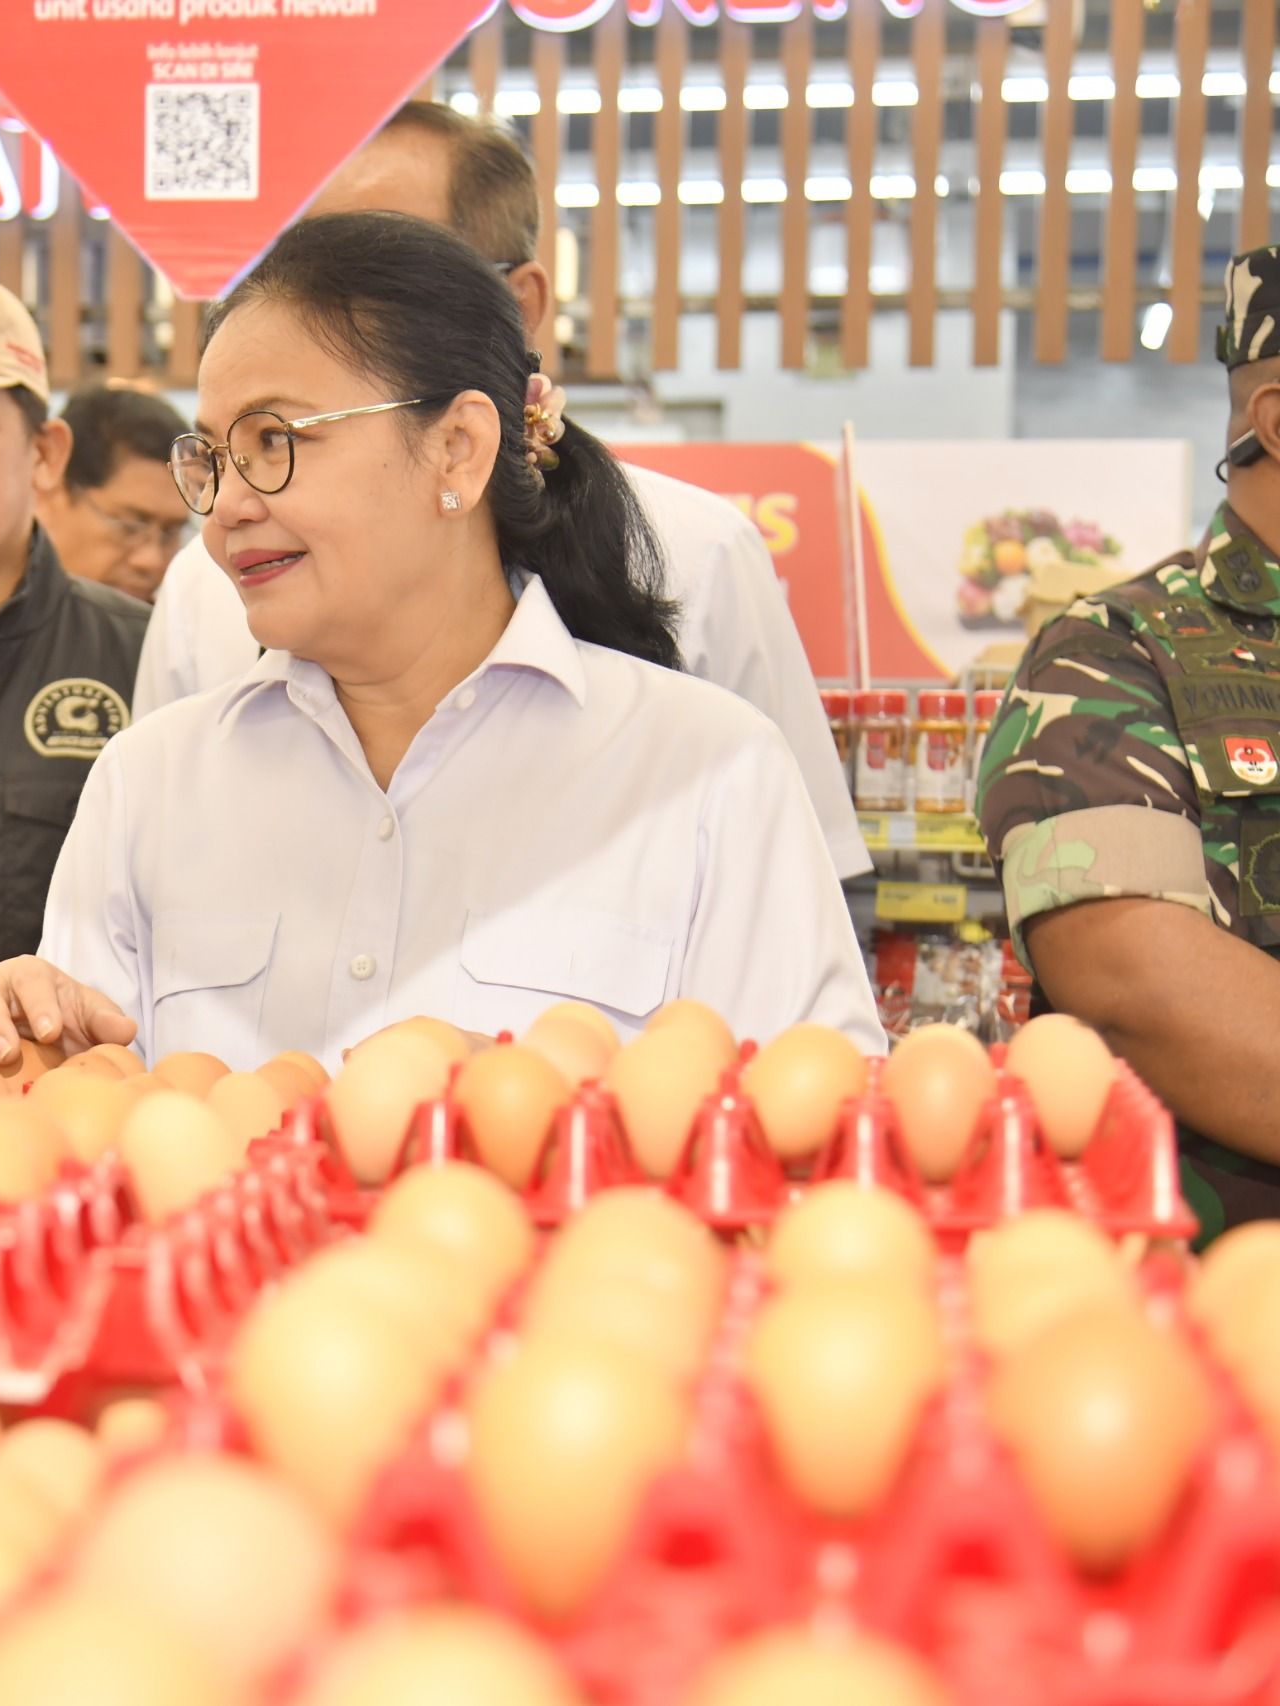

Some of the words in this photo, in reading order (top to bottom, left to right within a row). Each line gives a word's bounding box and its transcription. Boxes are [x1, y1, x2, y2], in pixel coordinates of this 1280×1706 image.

[152, 61, 197, 80] SCAN
[201, 61, 217, 80] DI
[221, 60, 254, 79] SINI
